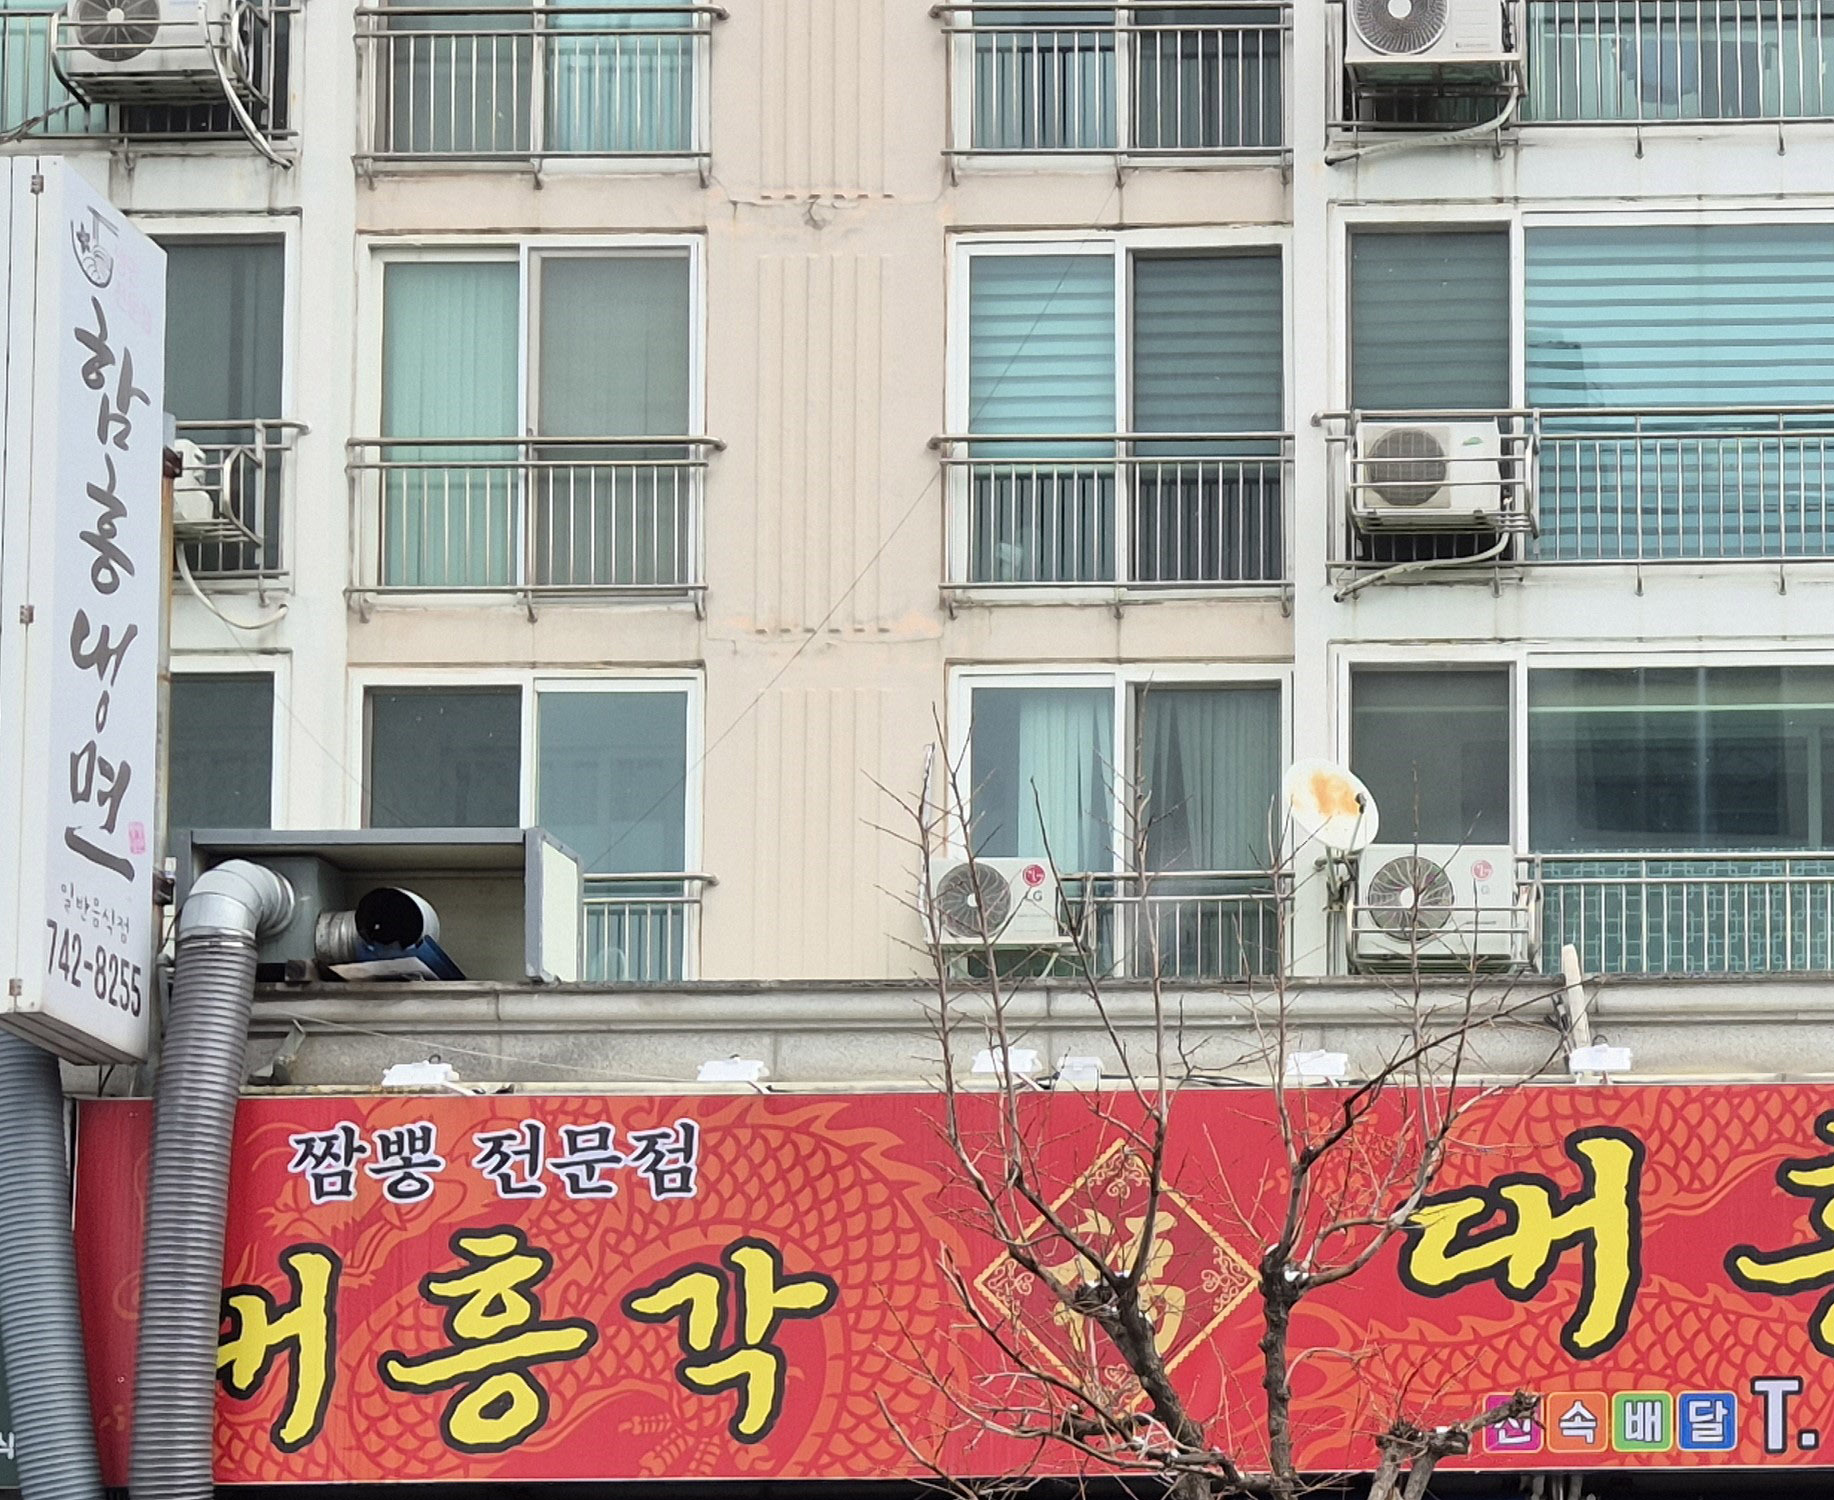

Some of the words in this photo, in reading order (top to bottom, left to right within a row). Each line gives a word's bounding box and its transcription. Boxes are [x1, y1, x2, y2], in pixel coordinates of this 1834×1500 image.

[65, 296, 151, 882] 함흥냉면
[61, 882, 130, 944] 일반음식점
[47, 918, 142, 1018] 742-8255
[289, 1118, 443, 1205] 짬뽕
[473, 1116, 700, 1200] 전문점
